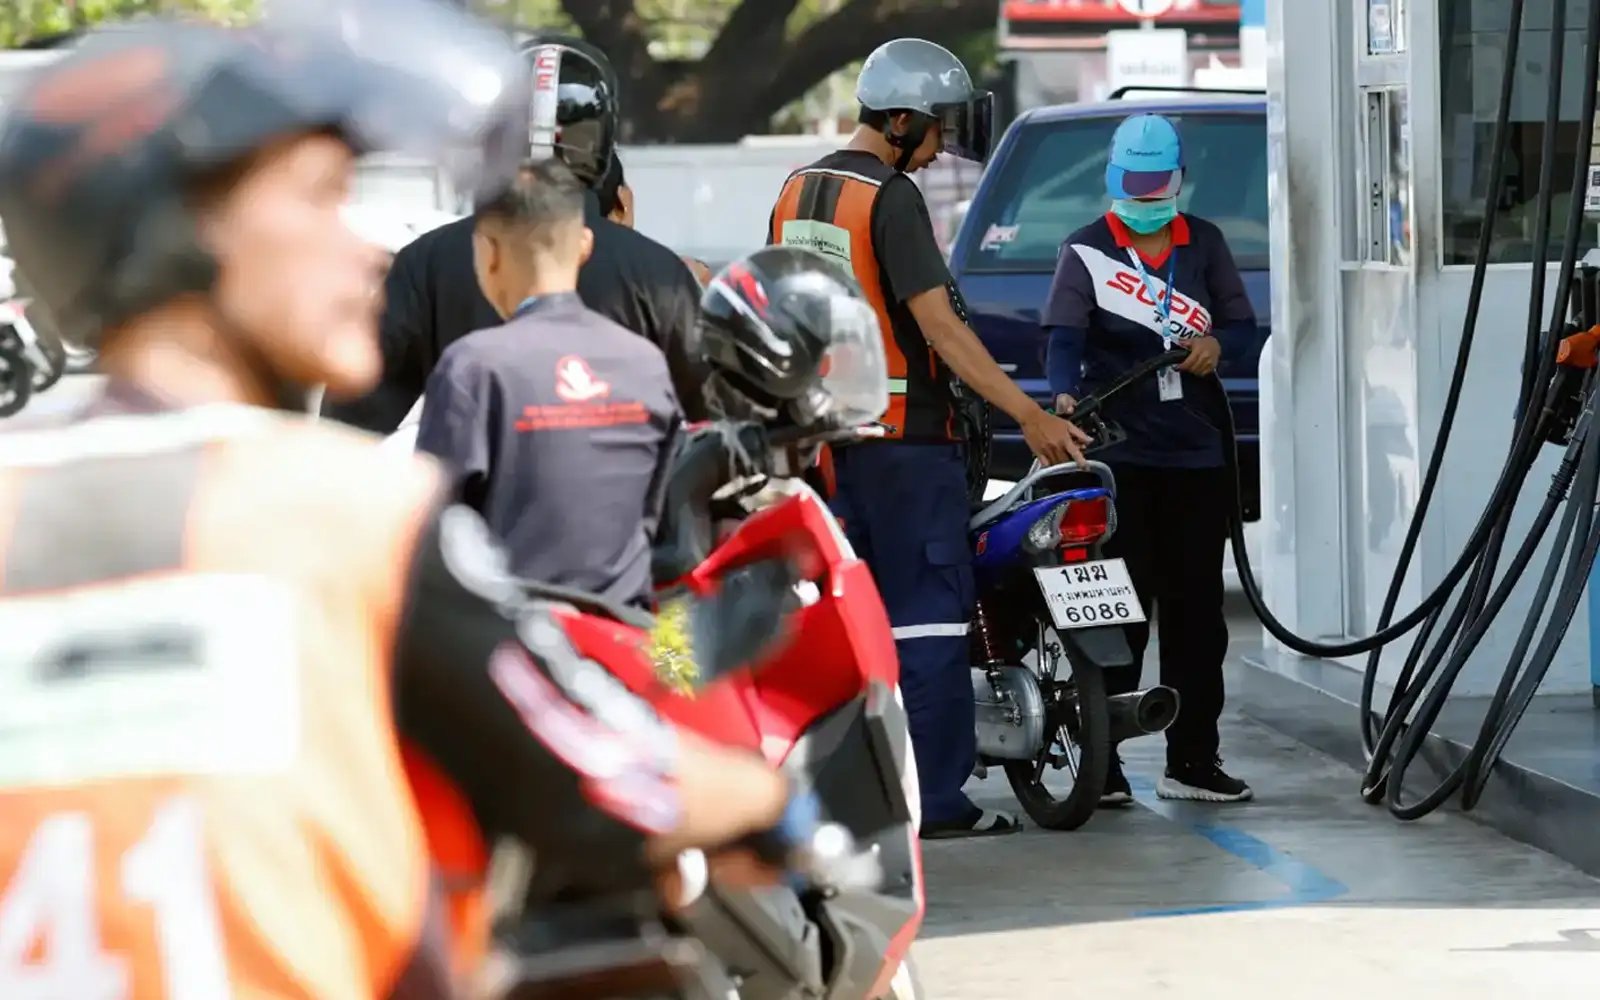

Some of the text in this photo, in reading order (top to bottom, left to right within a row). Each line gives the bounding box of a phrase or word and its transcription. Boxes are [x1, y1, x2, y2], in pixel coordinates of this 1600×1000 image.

[1106, 271, 1212, 333] SUPE
[1066, 602, 1130, 622] 6086
[0, 797, 232, 1000] 41
